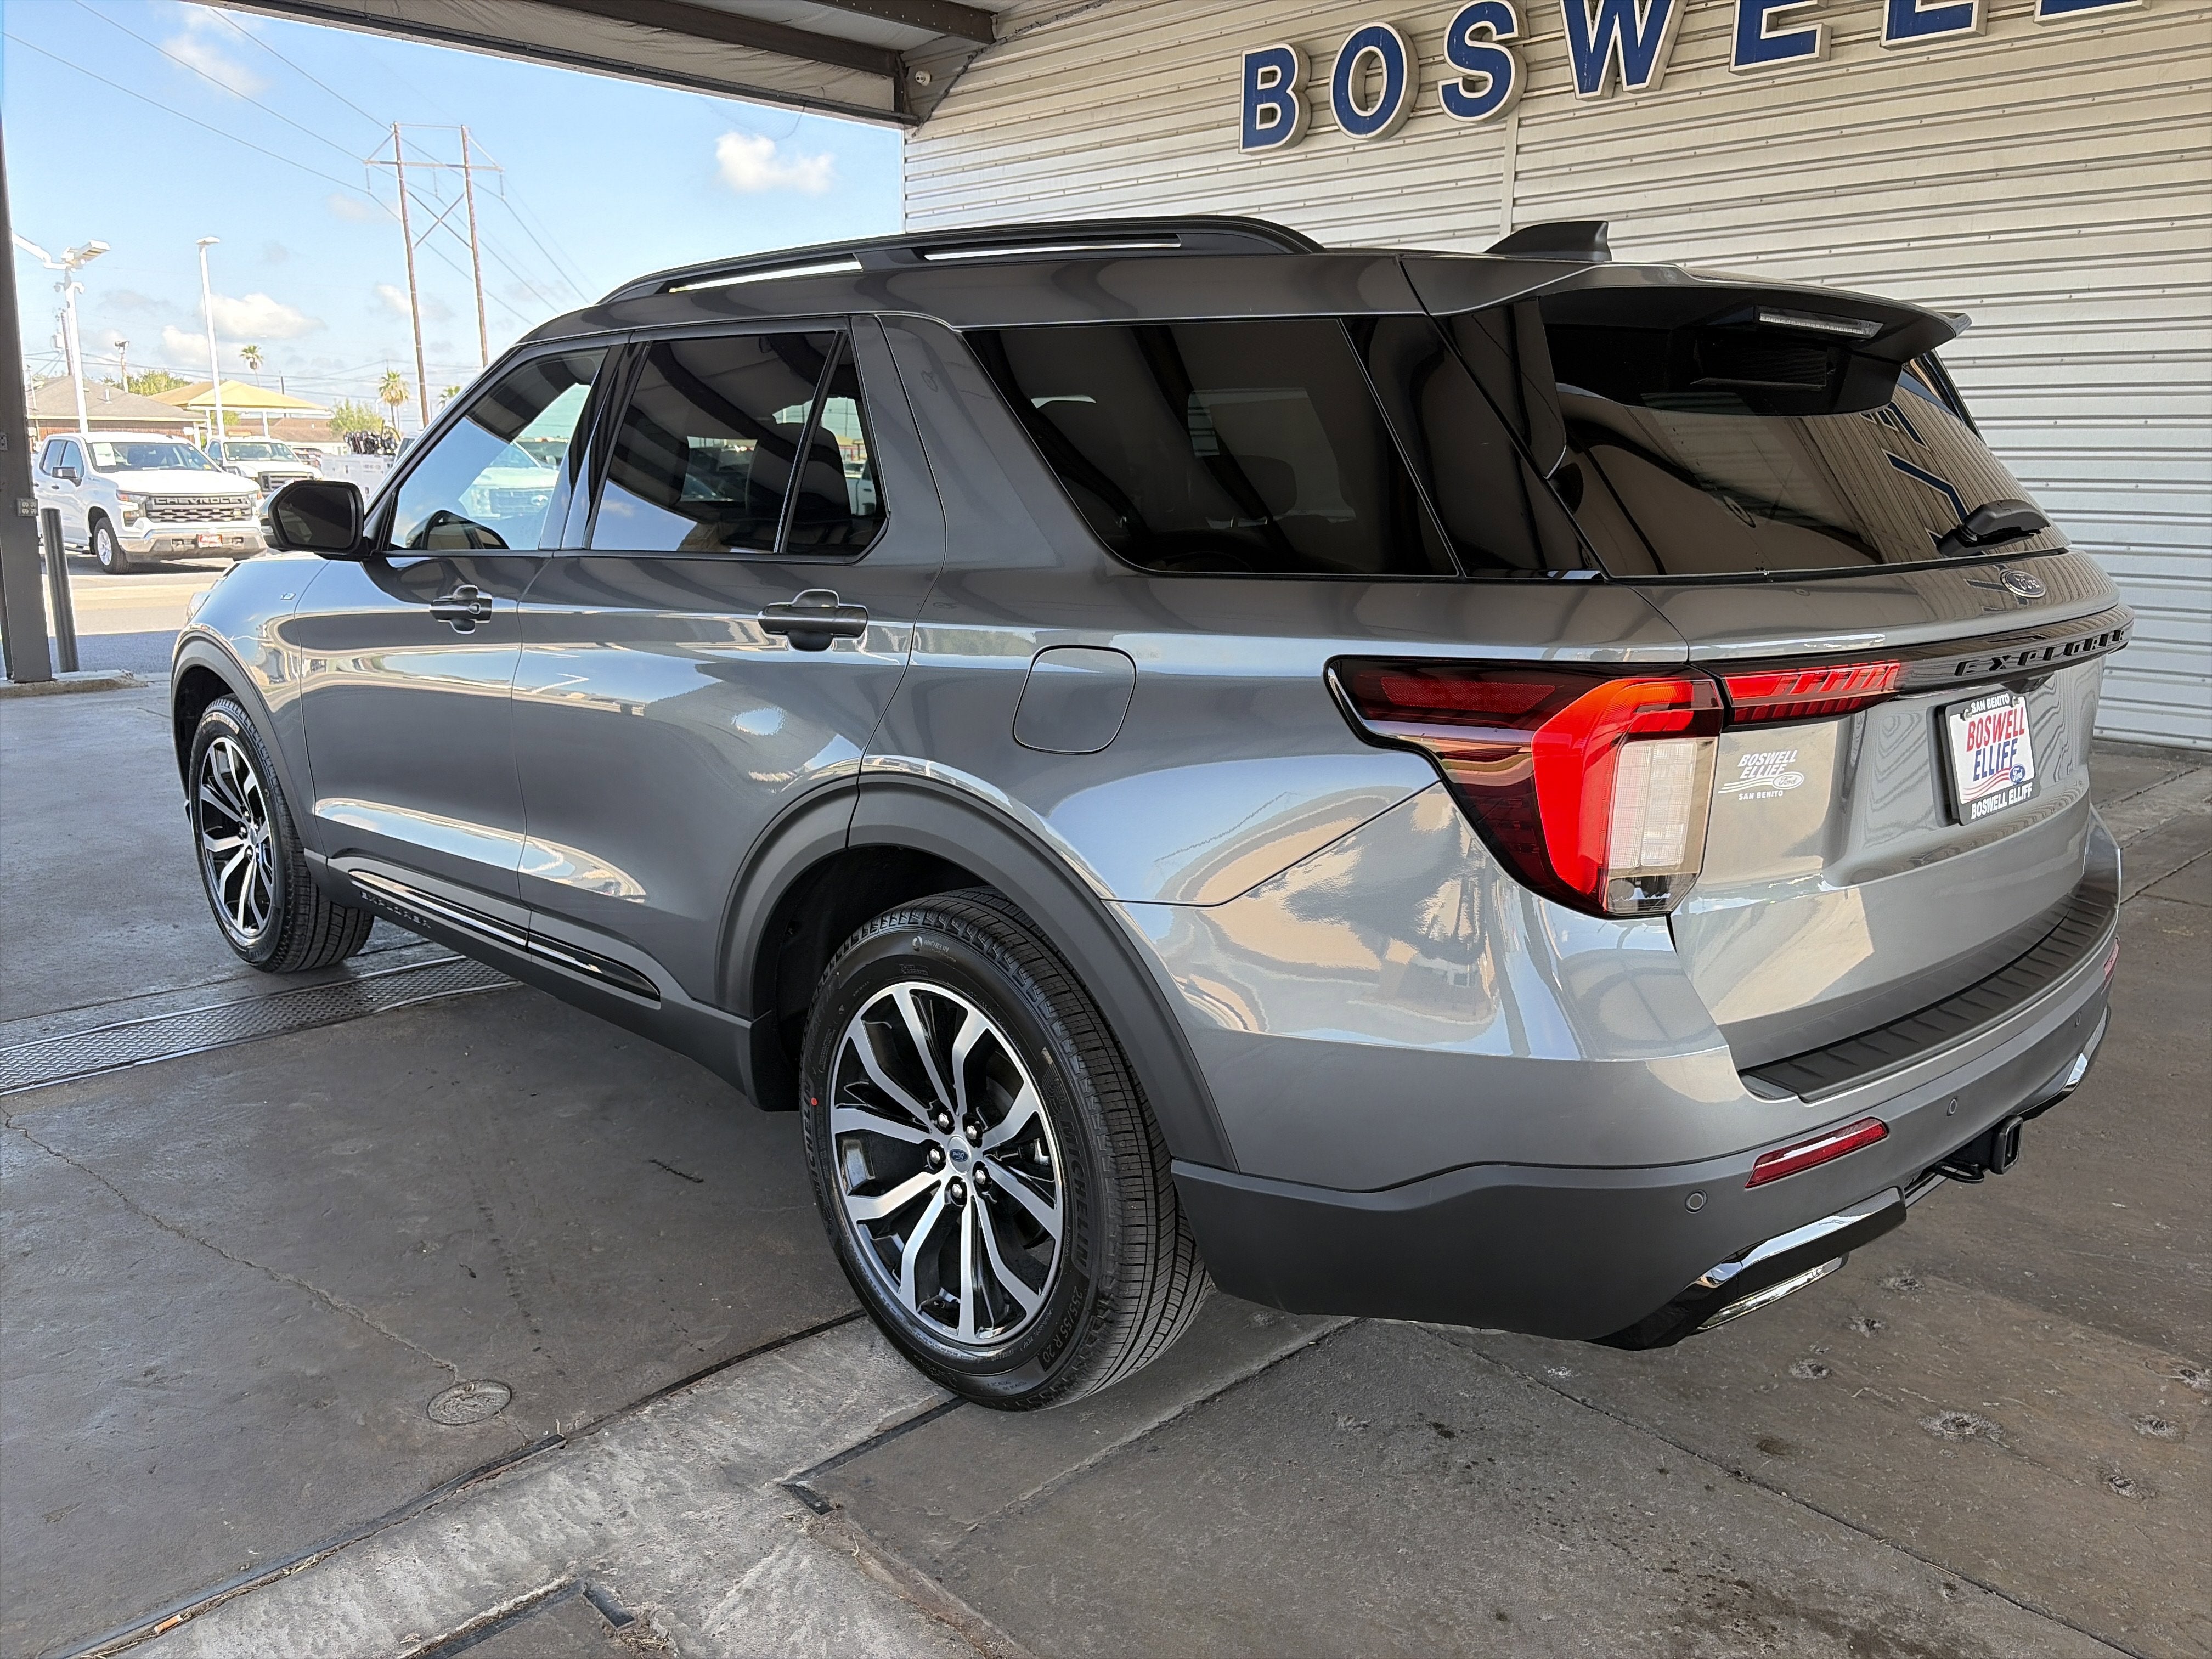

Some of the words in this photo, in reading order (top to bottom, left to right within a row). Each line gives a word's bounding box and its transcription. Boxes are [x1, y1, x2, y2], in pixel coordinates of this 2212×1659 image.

[1238, 0, 2149, 154] BOSWE
[1971, 699, 1986, 713] SAN
[1986, 693, 2010, 709] BENITO
[1967, 706, 2025, 752] BOSWELL
[1737, 750, 1798, 767] BOSWELL
[1973, 738, 2018, 782] ELLIFF
[1740, 764, 1787, 778] ELLIFF
[1778, 775, 1797, 786] Ford
[1756, 790, 1784, 799] BENITO
[1971, 792, 2007, 820] BOSWELL
[2008, 782, 2033, 805] ELLIFF
[924, 939, 950, 953] MICHELIN
[1060, 1120, 1089, 1267] MICHELIN
[1059, 1286, 1083, 1338] 255/55
[1053, 1334, 1063, 1348] R
[1043, 1344, 1056, 1363] 20
